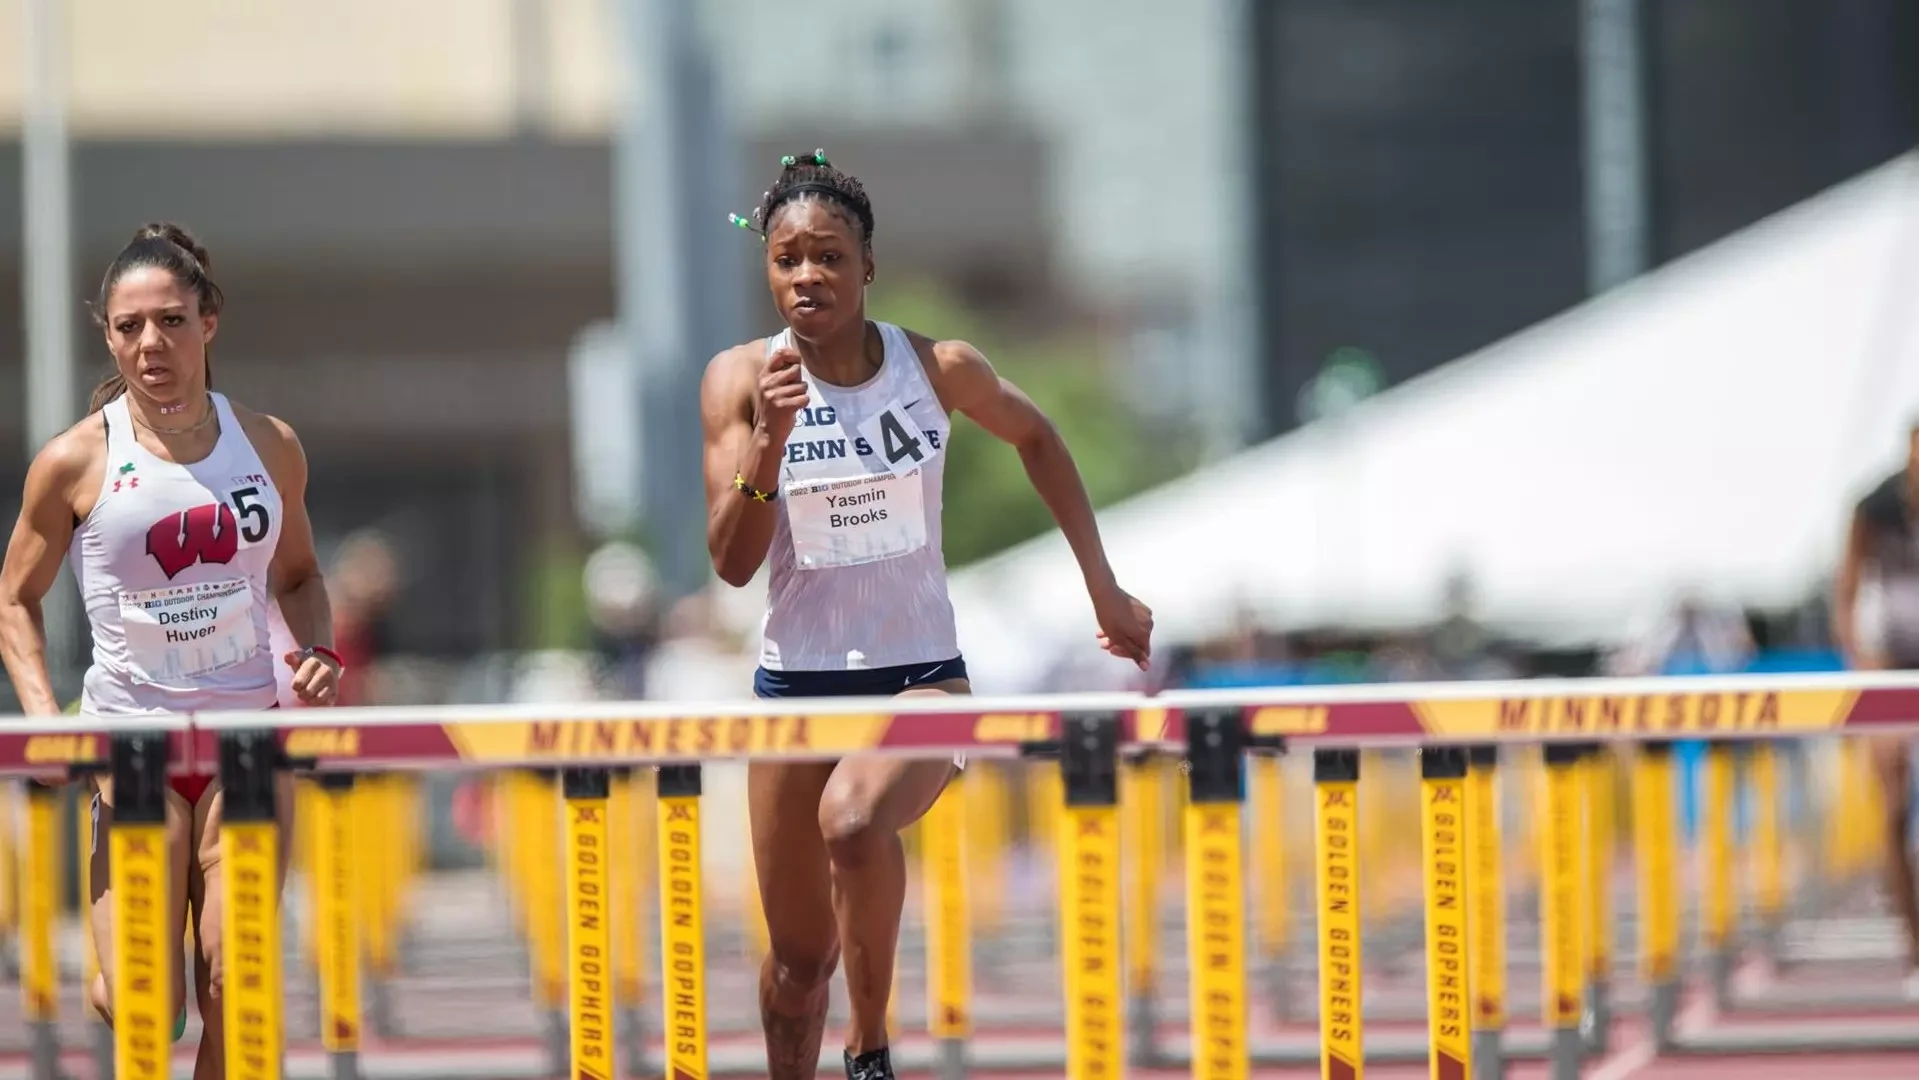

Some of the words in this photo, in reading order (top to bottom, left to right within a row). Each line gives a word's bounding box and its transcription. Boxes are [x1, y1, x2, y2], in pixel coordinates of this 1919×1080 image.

[783, 439, 846, 463] ENN
[879, 410, 925, 464] 4
[230, 486, 270, 543] 5
[790, 487, 808, 496] 2022
[831, 479, 862, 490] OUTDOOR
[825, 488, 886, 508] Yasmin
[830, 508, 888, 528] Brooks
[158, 606, 218, 625] Destiny
[164, 595, 195, 606] OUTDOOR
[166, 625, 216, 642] Huven
[527, 714, 812, 755] MINNESOTA
[1496, 690, 1780, 731] MINNESOTA
[577, 833, 600, 930] GOLDEN
[670, 830, 694, 928] GOLDEN
[1327, 816, 1350, 914] GOLDEN
[1434, 812, 1458, 910] GOLDEN
[579, 944, 604, 1059] GOPHERS
[673, 942, 698, 1056] GOPHERS
[1329, 928, 1352, 1041] GOPHERS
[1437, 924, 1461, 1038] GOPHERS
